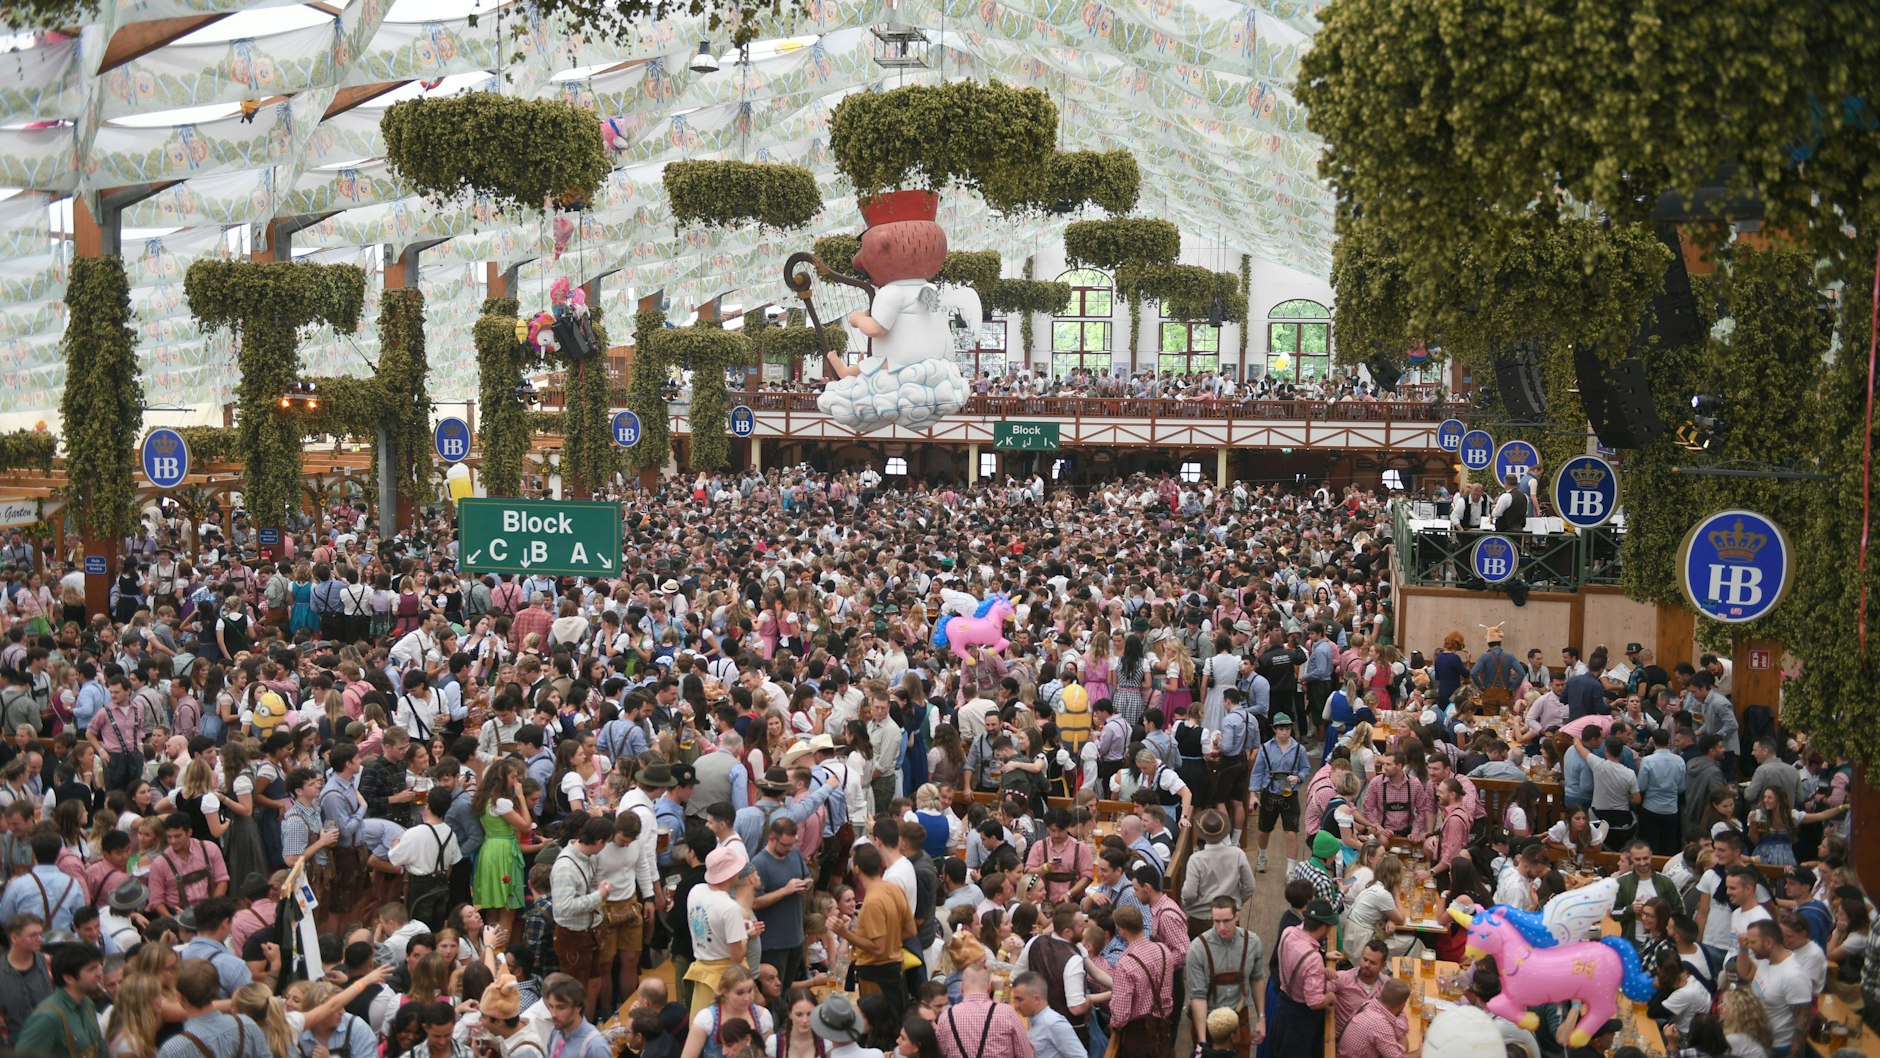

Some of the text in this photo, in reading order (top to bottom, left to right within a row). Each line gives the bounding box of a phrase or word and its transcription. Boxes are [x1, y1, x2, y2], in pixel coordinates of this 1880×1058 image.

[618, 428, 635, 442] HB
[735, 420, 750, 432] HB
[1012, 425, 1041, 435] Block
[443, 438, 463, 456] HB
[1005, 436, 1047, 446] K J I
[1443, 434, 1459, 447] HB
[1467, 449, 1487, 464] HB
[153, 457, 179, 479] HB
[1568, 490, 1603, 516] HB
[5, 505, 32, 523] Garten
[503, 510, 574, 534] Block
[489, 538, 589, 564] C B A
[1482, 557, 1506, 575] HB
[1708, 563, 1763, 606] HB
